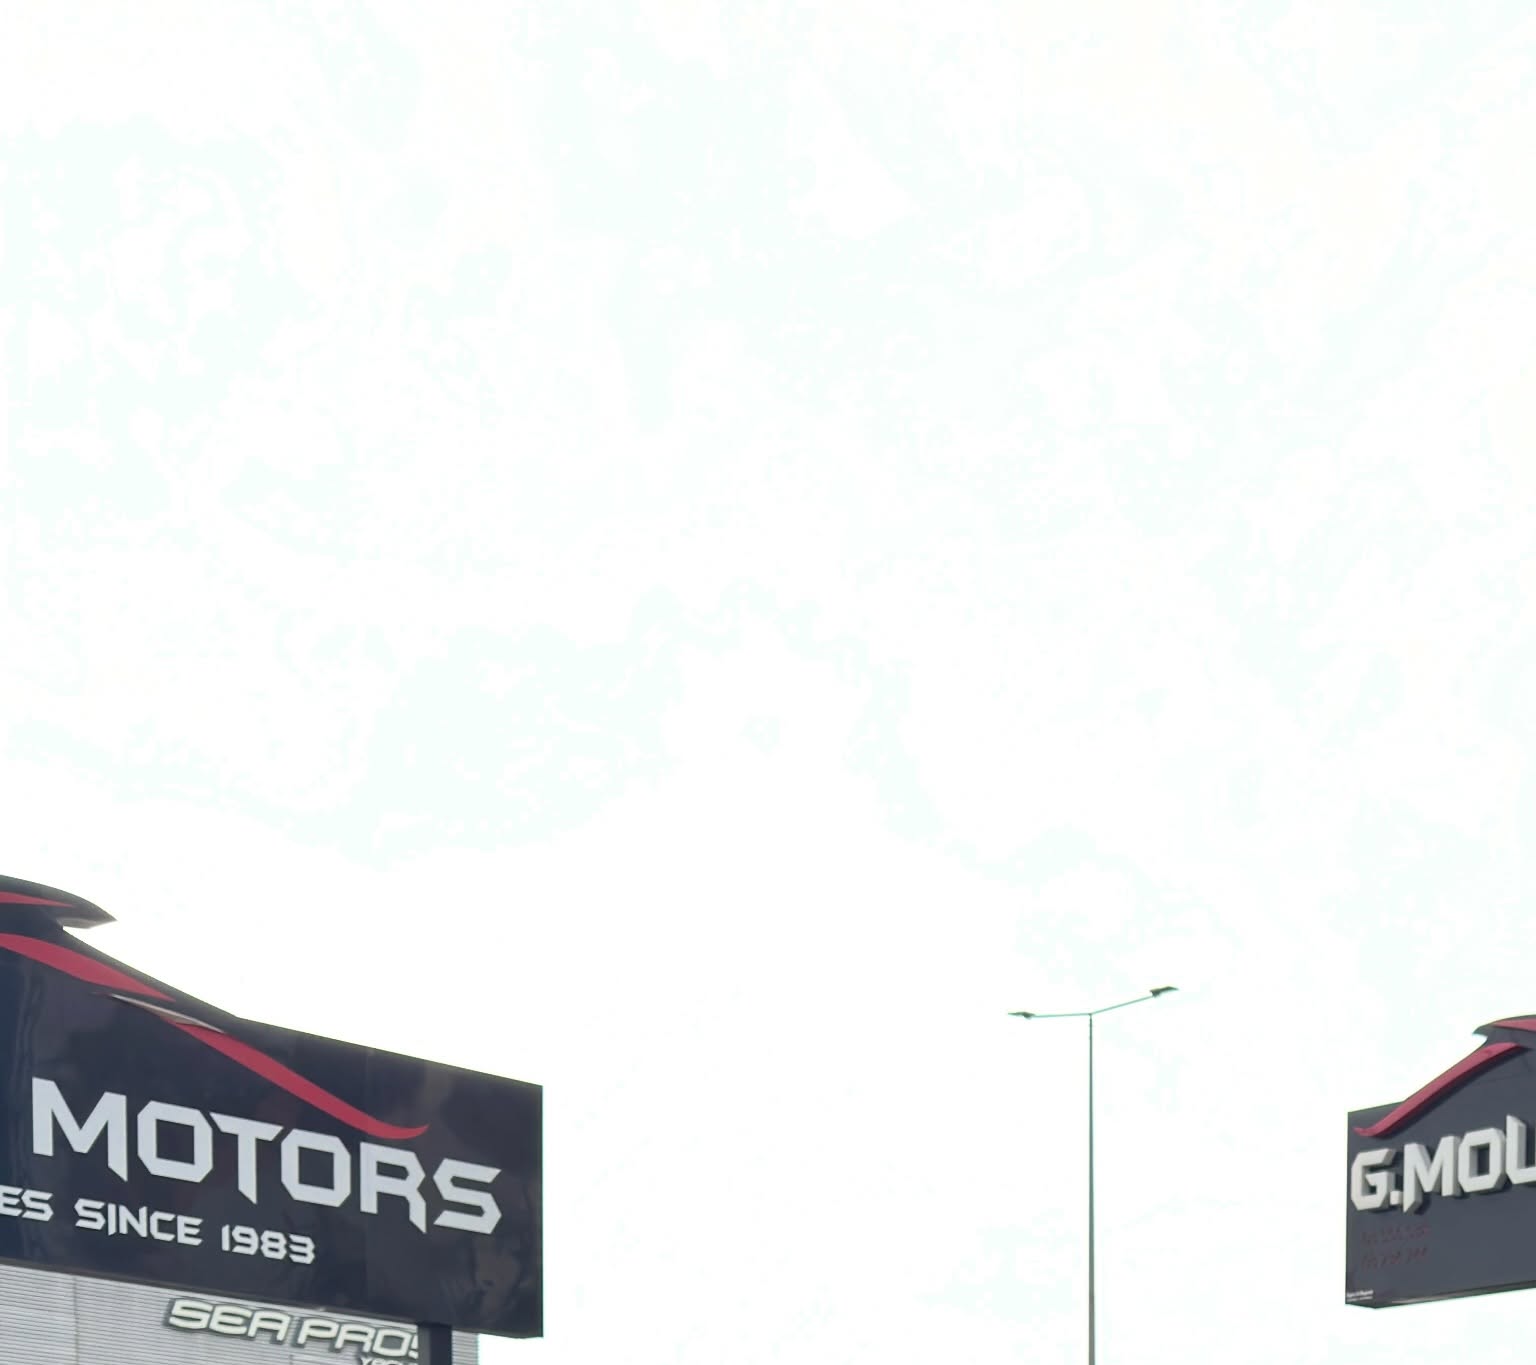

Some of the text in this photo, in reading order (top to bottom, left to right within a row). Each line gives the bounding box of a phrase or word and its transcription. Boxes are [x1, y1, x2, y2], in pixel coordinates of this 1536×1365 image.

[32, 1077, 502, 1234] MOTORS
[75, 1198, 203, 1246] SINCE
[221, 1224, 316, 1265] 1983
[168, 1299, 419, 1360] SEA PRO
